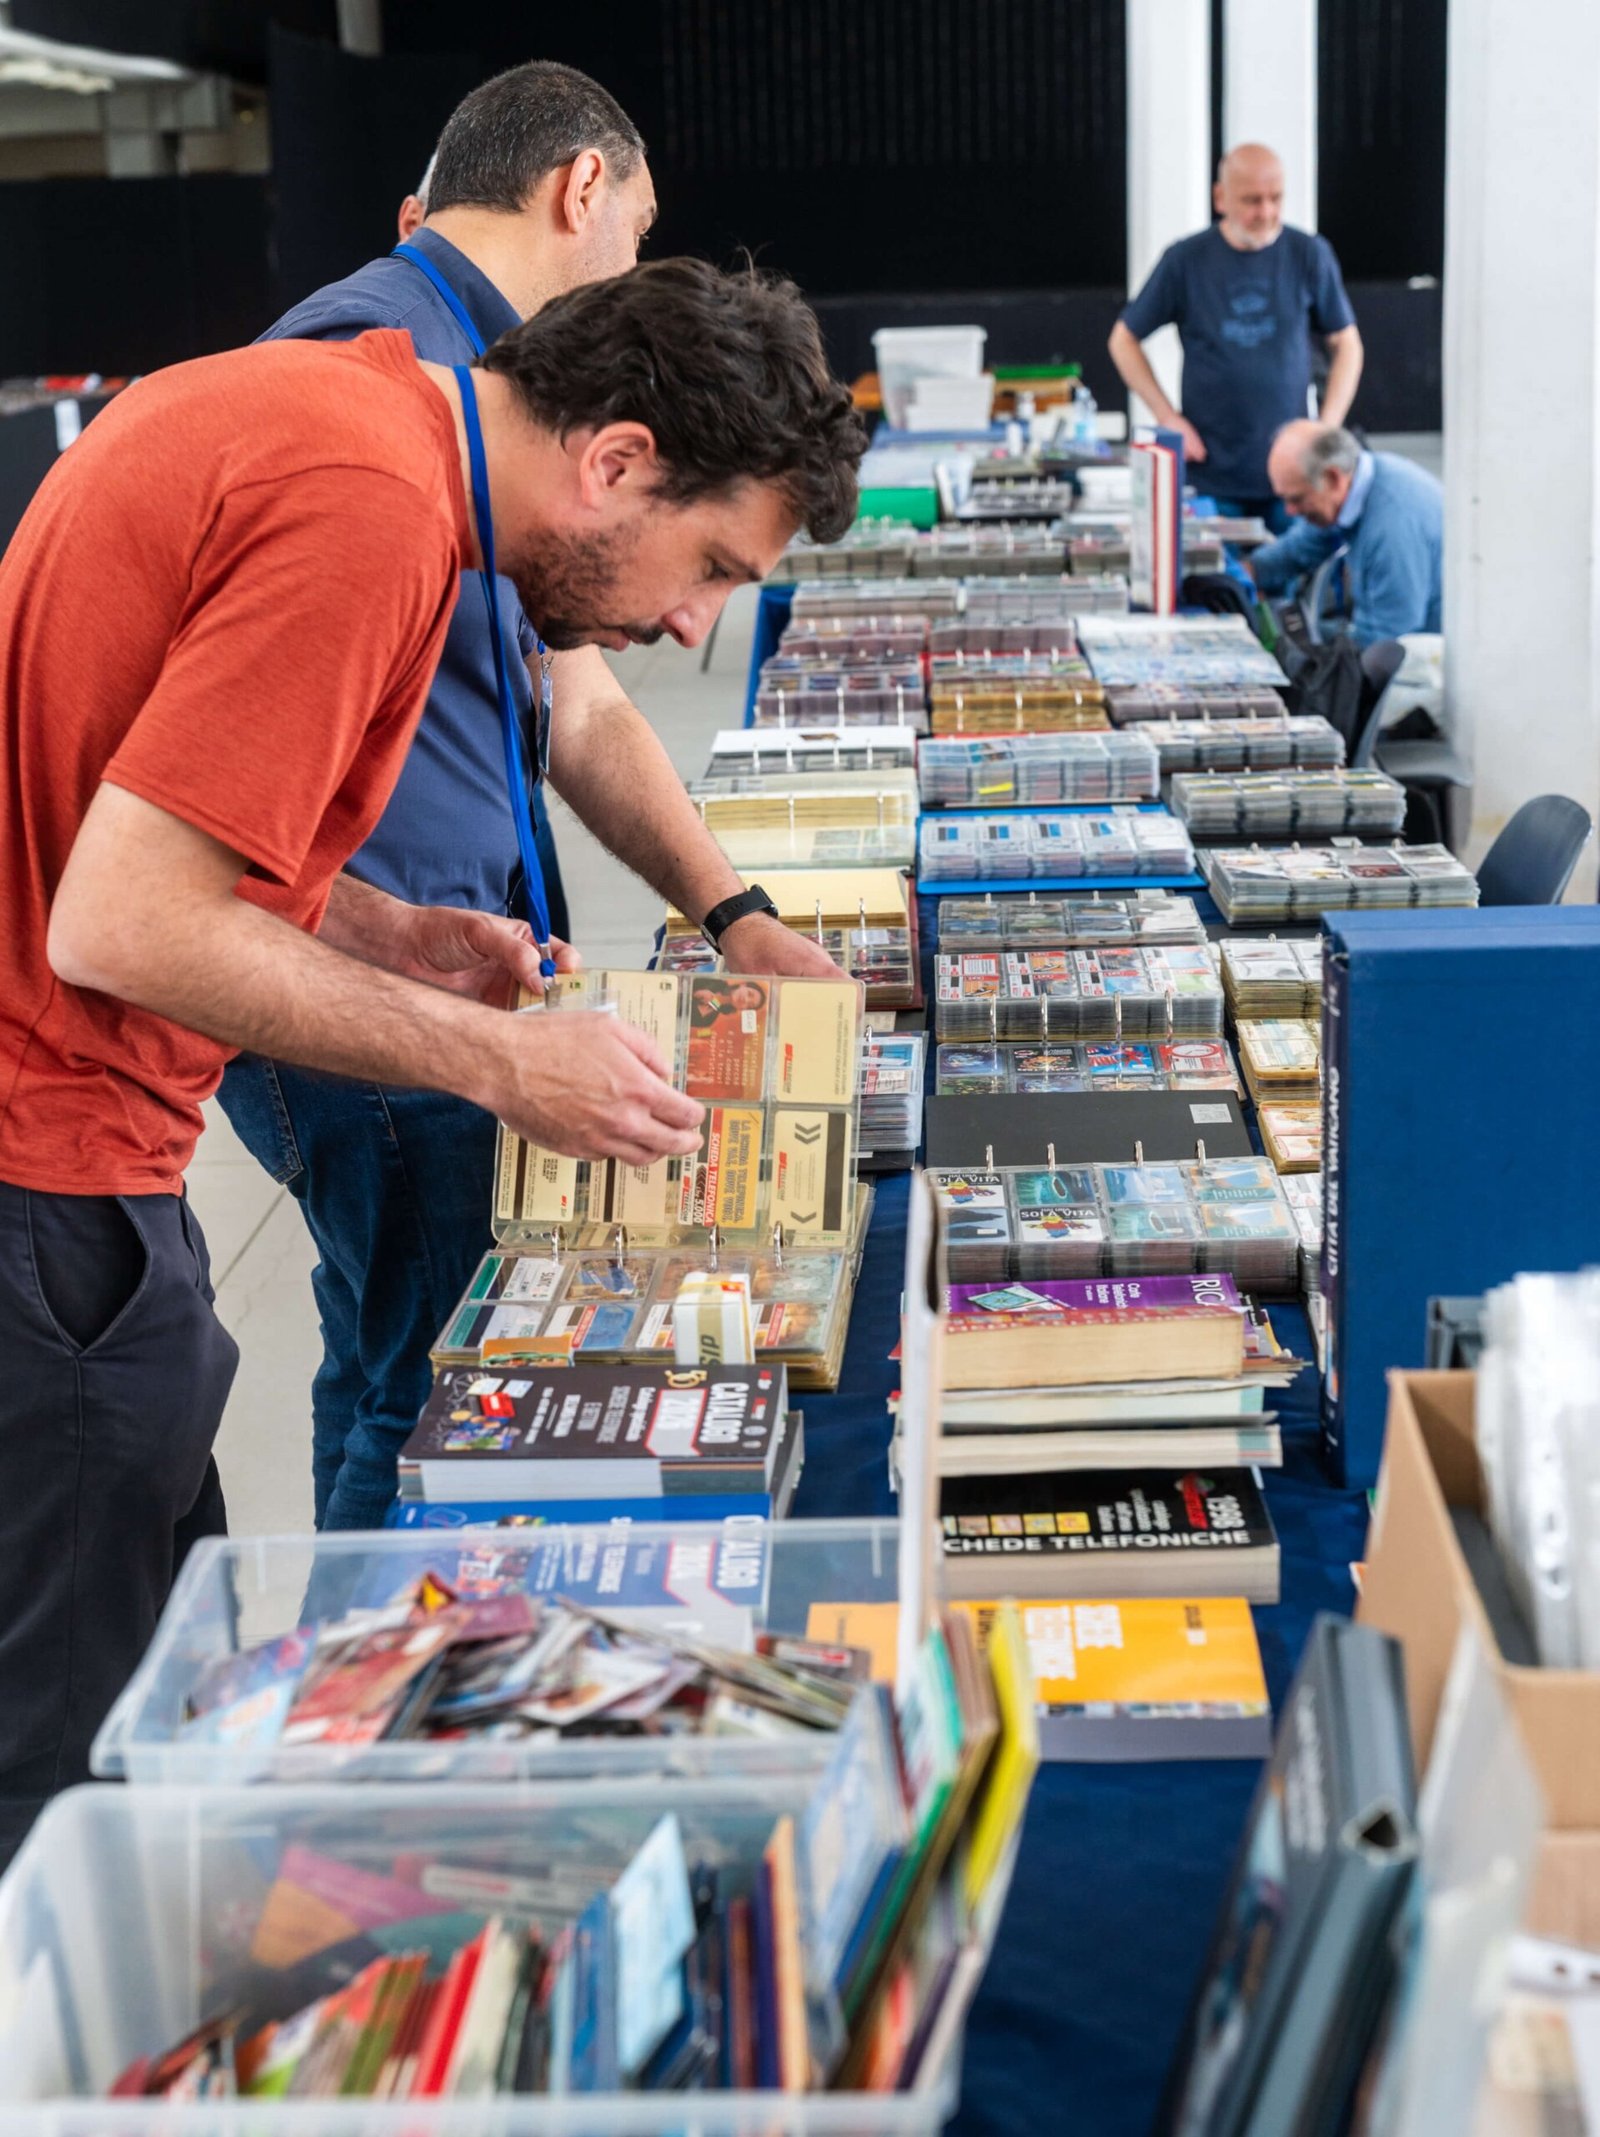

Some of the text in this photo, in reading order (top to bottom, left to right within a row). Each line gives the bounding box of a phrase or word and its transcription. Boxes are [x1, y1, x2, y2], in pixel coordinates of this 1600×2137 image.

[728, 1119, 739, 1144] DOVE
[741, 1119, 751, 1132] LA
[1328, 1066, 1341, 1172] VATICANO
[739, 1133, 750, 1167] SCHEDA
[705, 1132, 721, 1223] SCHEDA TELEFONICA
[724, 1169, 736, 1194] DOVE
[970, 1175, 1000, 1183] VITA
[1327, 1179, 1340, 1217] DEL
[693, 1199, 704, 1223] 5.000
[1021, 1209, 1095, 1218] SOLA VITA
[699, 1382, 750, 1443] CATALOGO
[1206, 1494, 1246, 1530] 1998
[943, 1529, 1251, 1553] CHEDE TELEFONICHE
